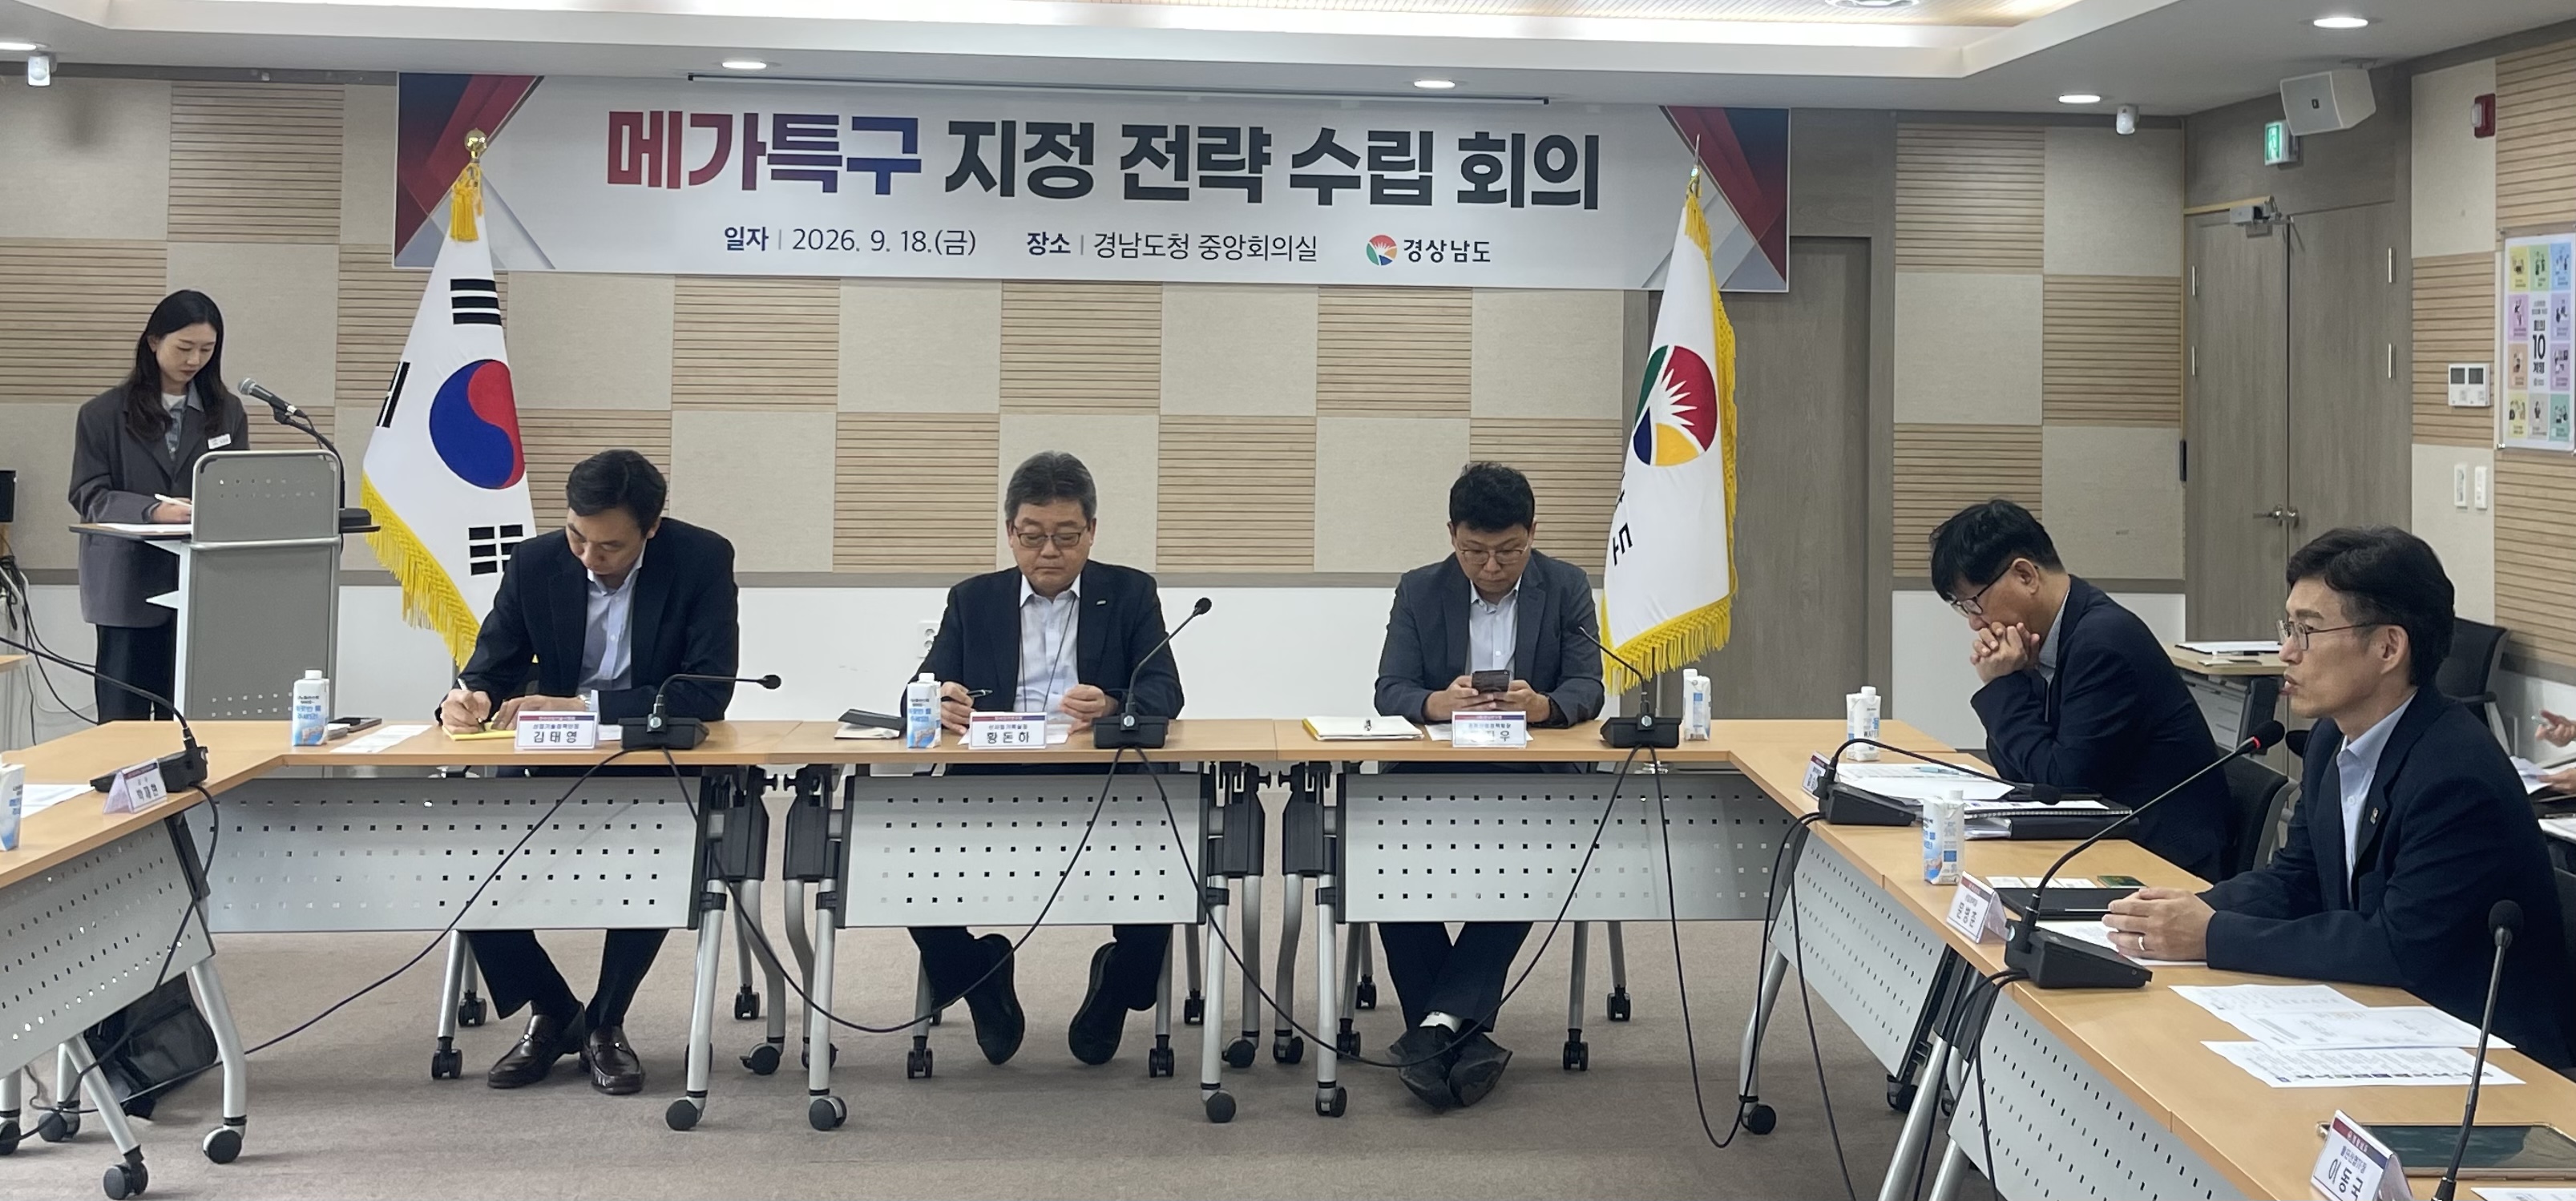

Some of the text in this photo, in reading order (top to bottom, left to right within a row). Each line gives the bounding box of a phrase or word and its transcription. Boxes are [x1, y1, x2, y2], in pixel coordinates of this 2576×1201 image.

[607, 110, 1600, 211] 메가특구 지정 전략 수립 회의
[724, 226, 976, 256] 일자 2026. 9. 18.(금)
[1027, 231, 1317, 262] 장소 경남도청 중앙회의실
[1403, 239, 1491, 264] 경상남도
[2532, 333, 2546, 360] 10
[534, 731, 578, 744] 김태영
